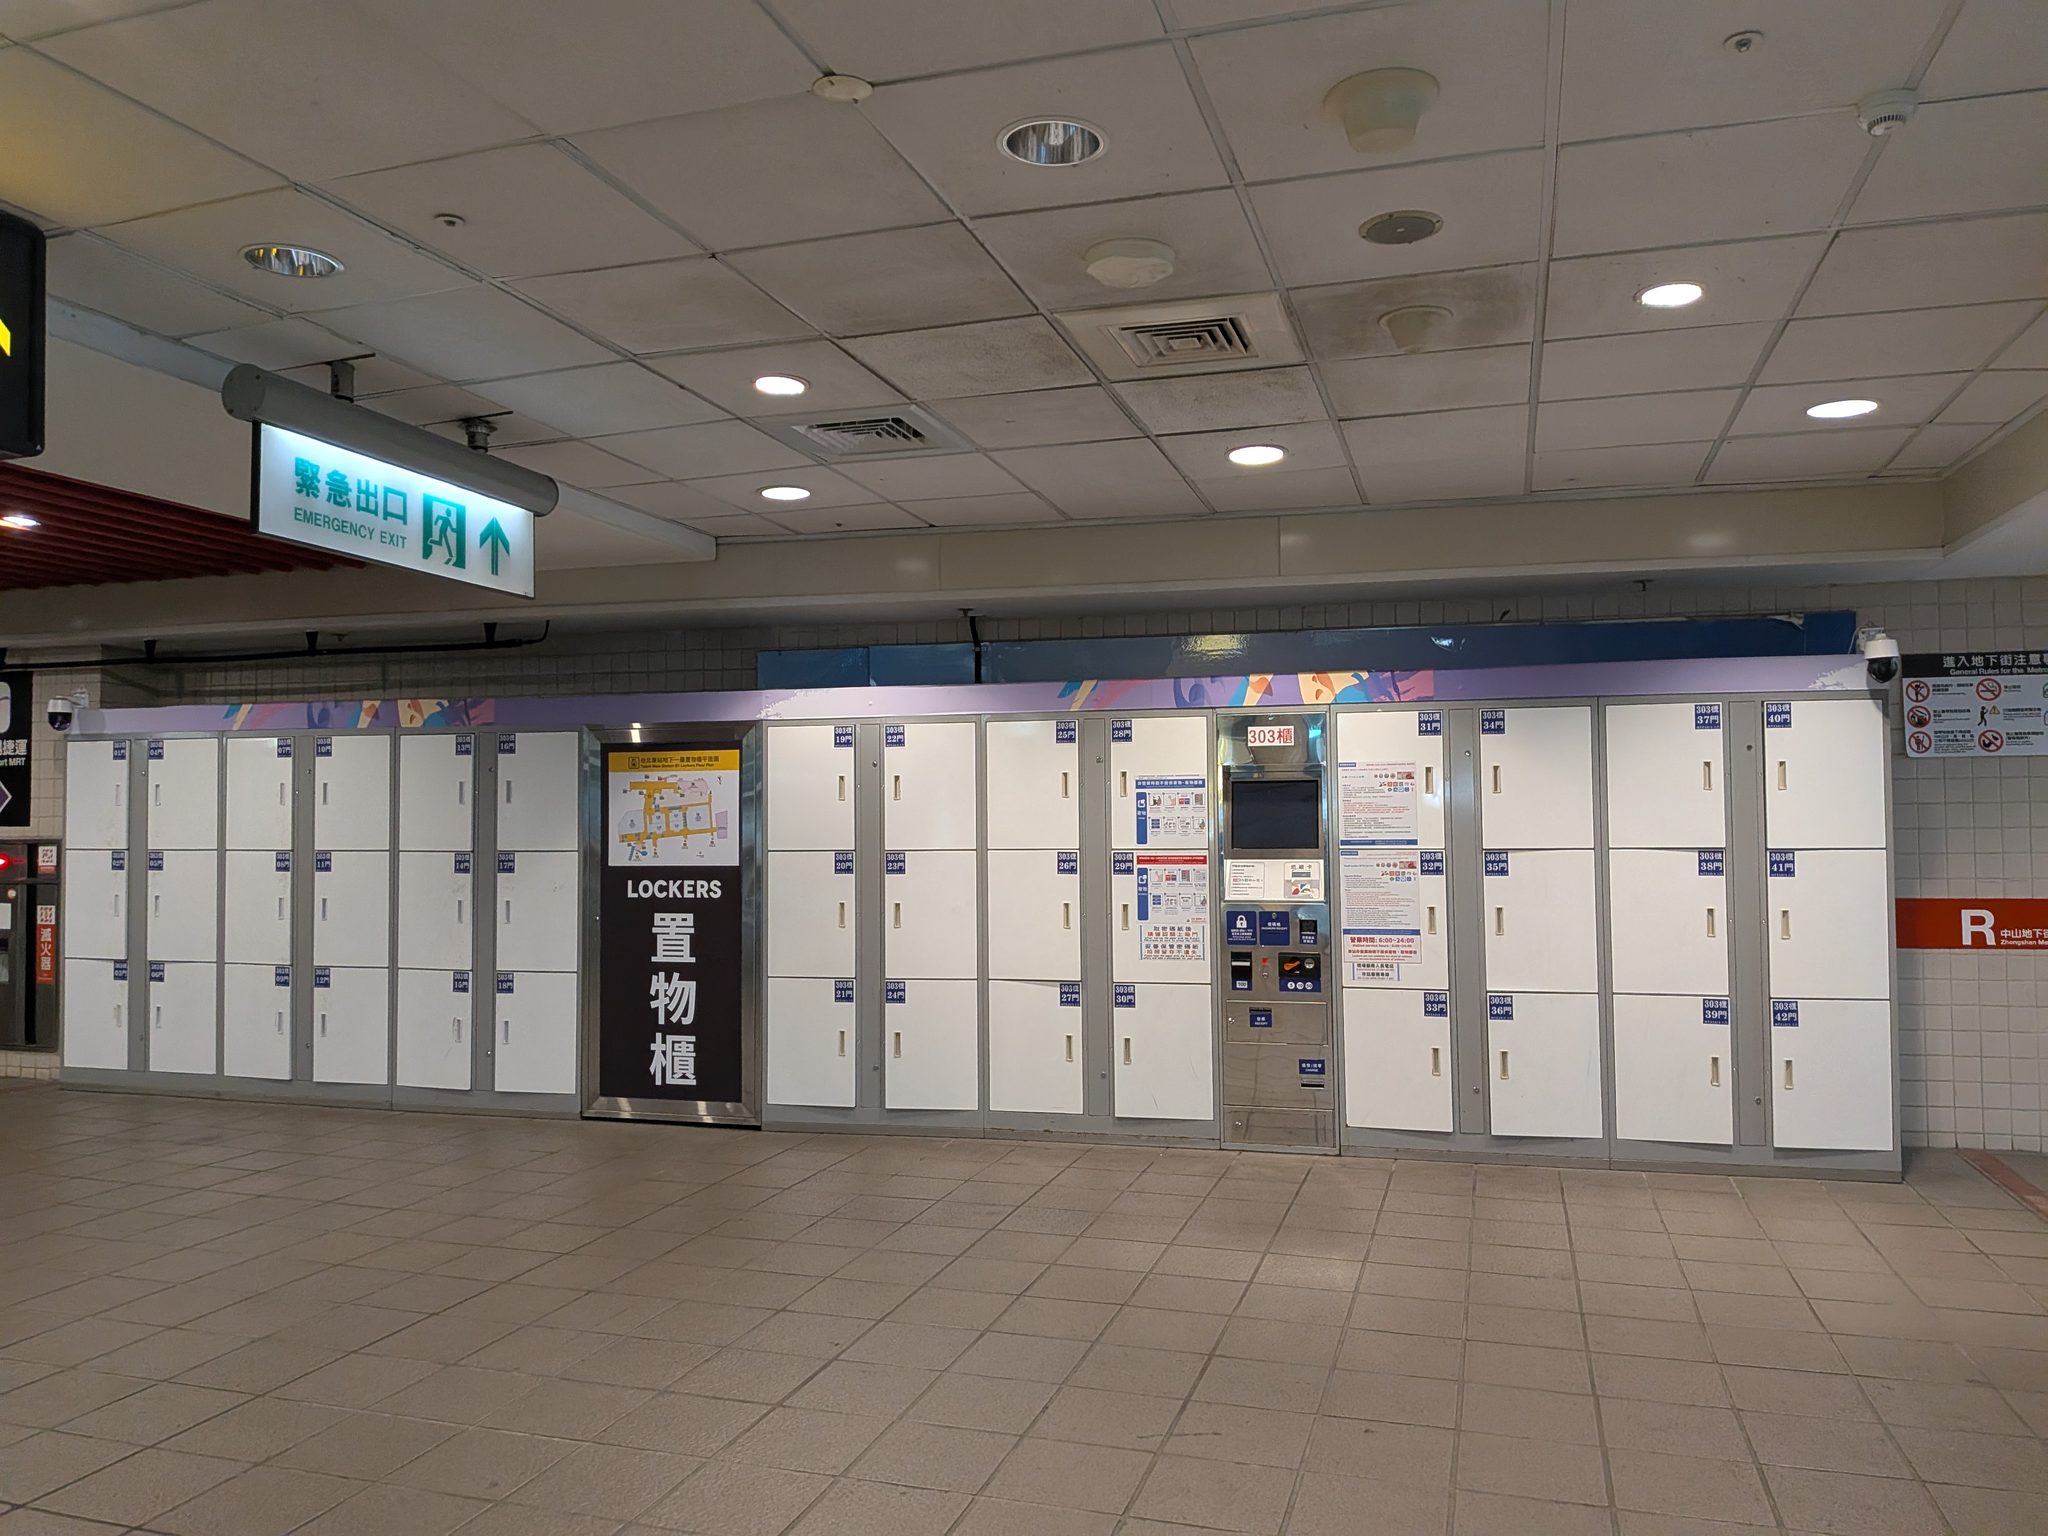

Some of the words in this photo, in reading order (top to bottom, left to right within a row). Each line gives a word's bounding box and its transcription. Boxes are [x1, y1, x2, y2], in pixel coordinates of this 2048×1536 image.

[294, 456, 408, 526] 緊急出口
[293, 506, 375, 541] EMERGENCY
[380, 530, 408, 549] EXIT
[1949, 668, 1978, 676] General
[1698, 716, 1719, 724] 37門
[1768, 714, 1790, 722] 40門
[1421, 723, 1440, 731] 31門
[1484, 721, 1503, 729] 34門
[1058, 731, 1075, 739] 25門
[1114, 730, 1131, 738] 28門
[1248, 727, 1293, 744] 303櫃
[0, 739, 28, 756] 捷運
[8, 757, 26, 766] MRT
[1059, 862, 1076, 870] 26門
[1115, 862, 1132, 870] 29門
[1423, 862, 1442, 870] 32門
[1487, 863, 1506, 871] 35門
[1701, 862, 1722, 870] 38門
[1772, 863, 1794, 872] 41門
[627, 879, 722, 899] LOCKERS
[1961, 909, 1997, 946] R
[649, 912, 697, 1086] 置物櫃
[1062, 994, 1079, 1002] 27門
[1426, 1004, 1446, 1012] 33門
[1492, 1006, 1512, 1014] 36門
[1706, 1010, 1727, 1019] 39門
[1776, 1012, 1797, 1021] 42門
